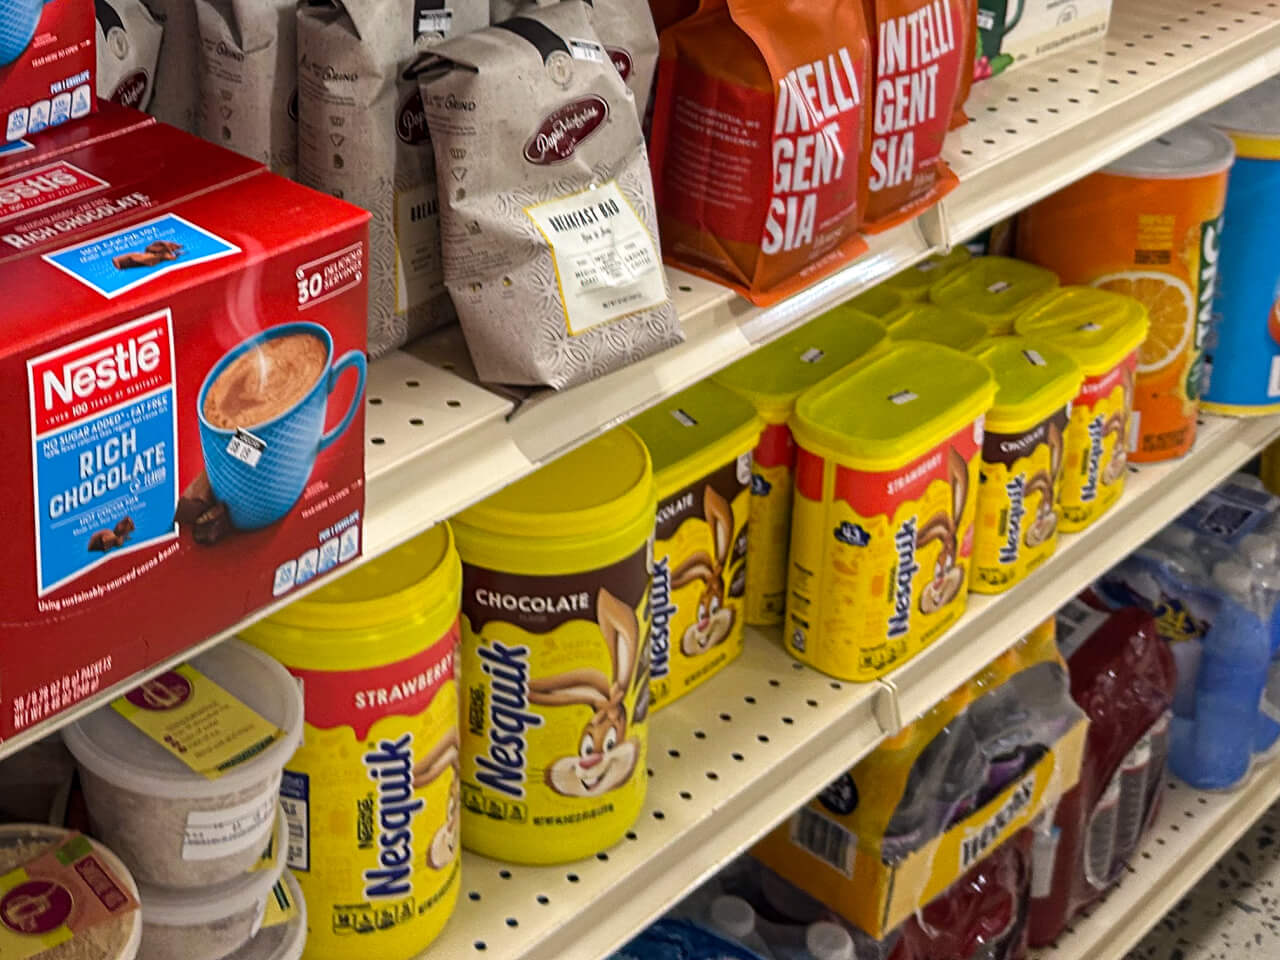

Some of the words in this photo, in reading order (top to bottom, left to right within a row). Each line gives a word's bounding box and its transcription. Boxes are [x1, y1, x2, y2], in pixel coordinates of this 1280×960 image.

[874, 63, 940, 136] GENT
[773, 121, 845, 195] GENT
[867, 132, 915, 192] SIA
[54, 192, 151, 233] CHOCOLATE
[761, 194, 818, 256] SIA
[296, 271, 323, 305] 30
[42, 329, 163, 411] Nestlé
[59, 425, 90, 446] SUGAR
[71, 401, 89, 418] 100
[48, 441, 167, 520] CHOCOLATE
[78, 427, 138, 481] RICH
[887, 453, 943, 496] STRAWBERRY
[1081, 413, 1106, 502] Nesquik
[999, 472, 1027, 565] Nesquik
[37, 597, 61, 613] Using
[61, 567, 138, 609] sustainably-sourced
[475, 588, 590, 614] CHOCOLATE
[886, 516, 920, 639] Nesquik
[649, 557, 677, 678] Nesquik
[354, 654, 455, 710] STRAWBERRY
[474, 641, 543, 798] Nesquik
[363, 732, 425, 900] Nesquik
